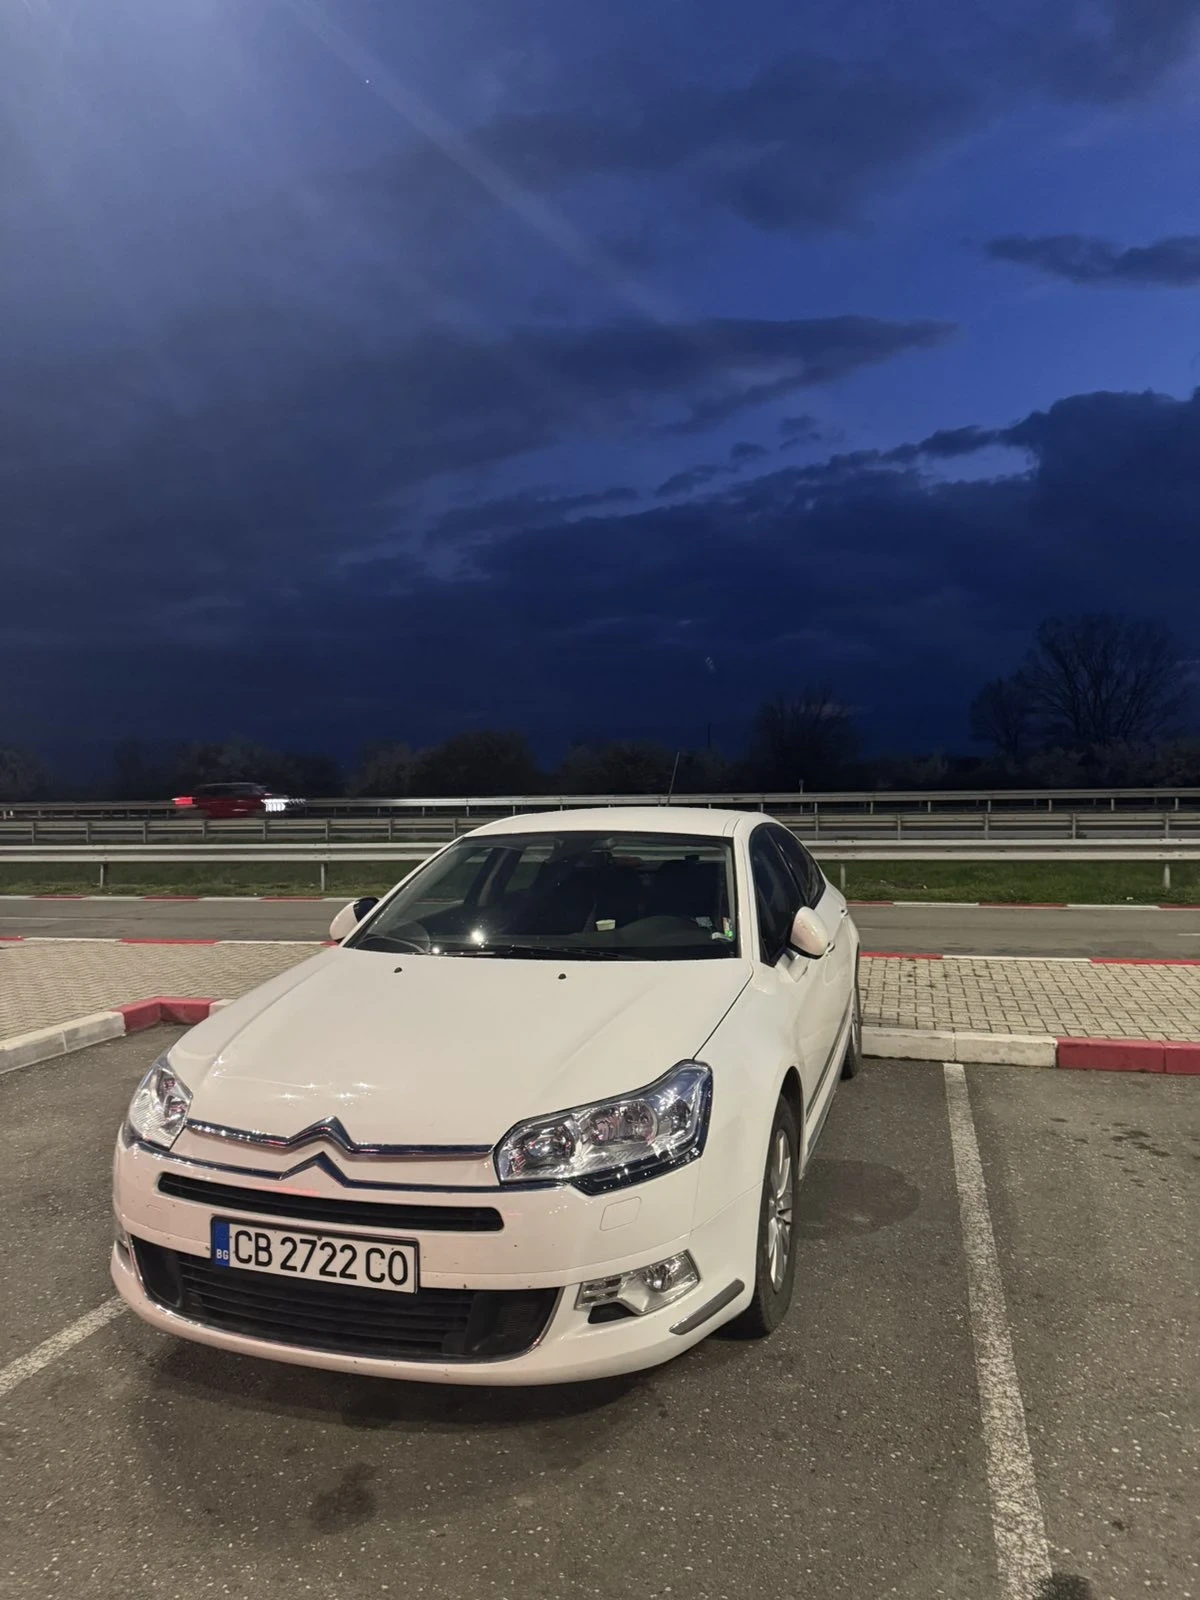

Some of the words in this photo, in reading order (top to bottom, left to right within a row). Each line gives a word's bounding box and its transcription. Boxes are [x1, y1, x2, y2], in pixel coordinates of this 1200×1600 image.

[216, 1249, 229, 1260] BG
[234, 1230, 273, 1267] CB
[280, 1236, 357, 1280] 2722
[365, 1247, 408, 1286] CO
